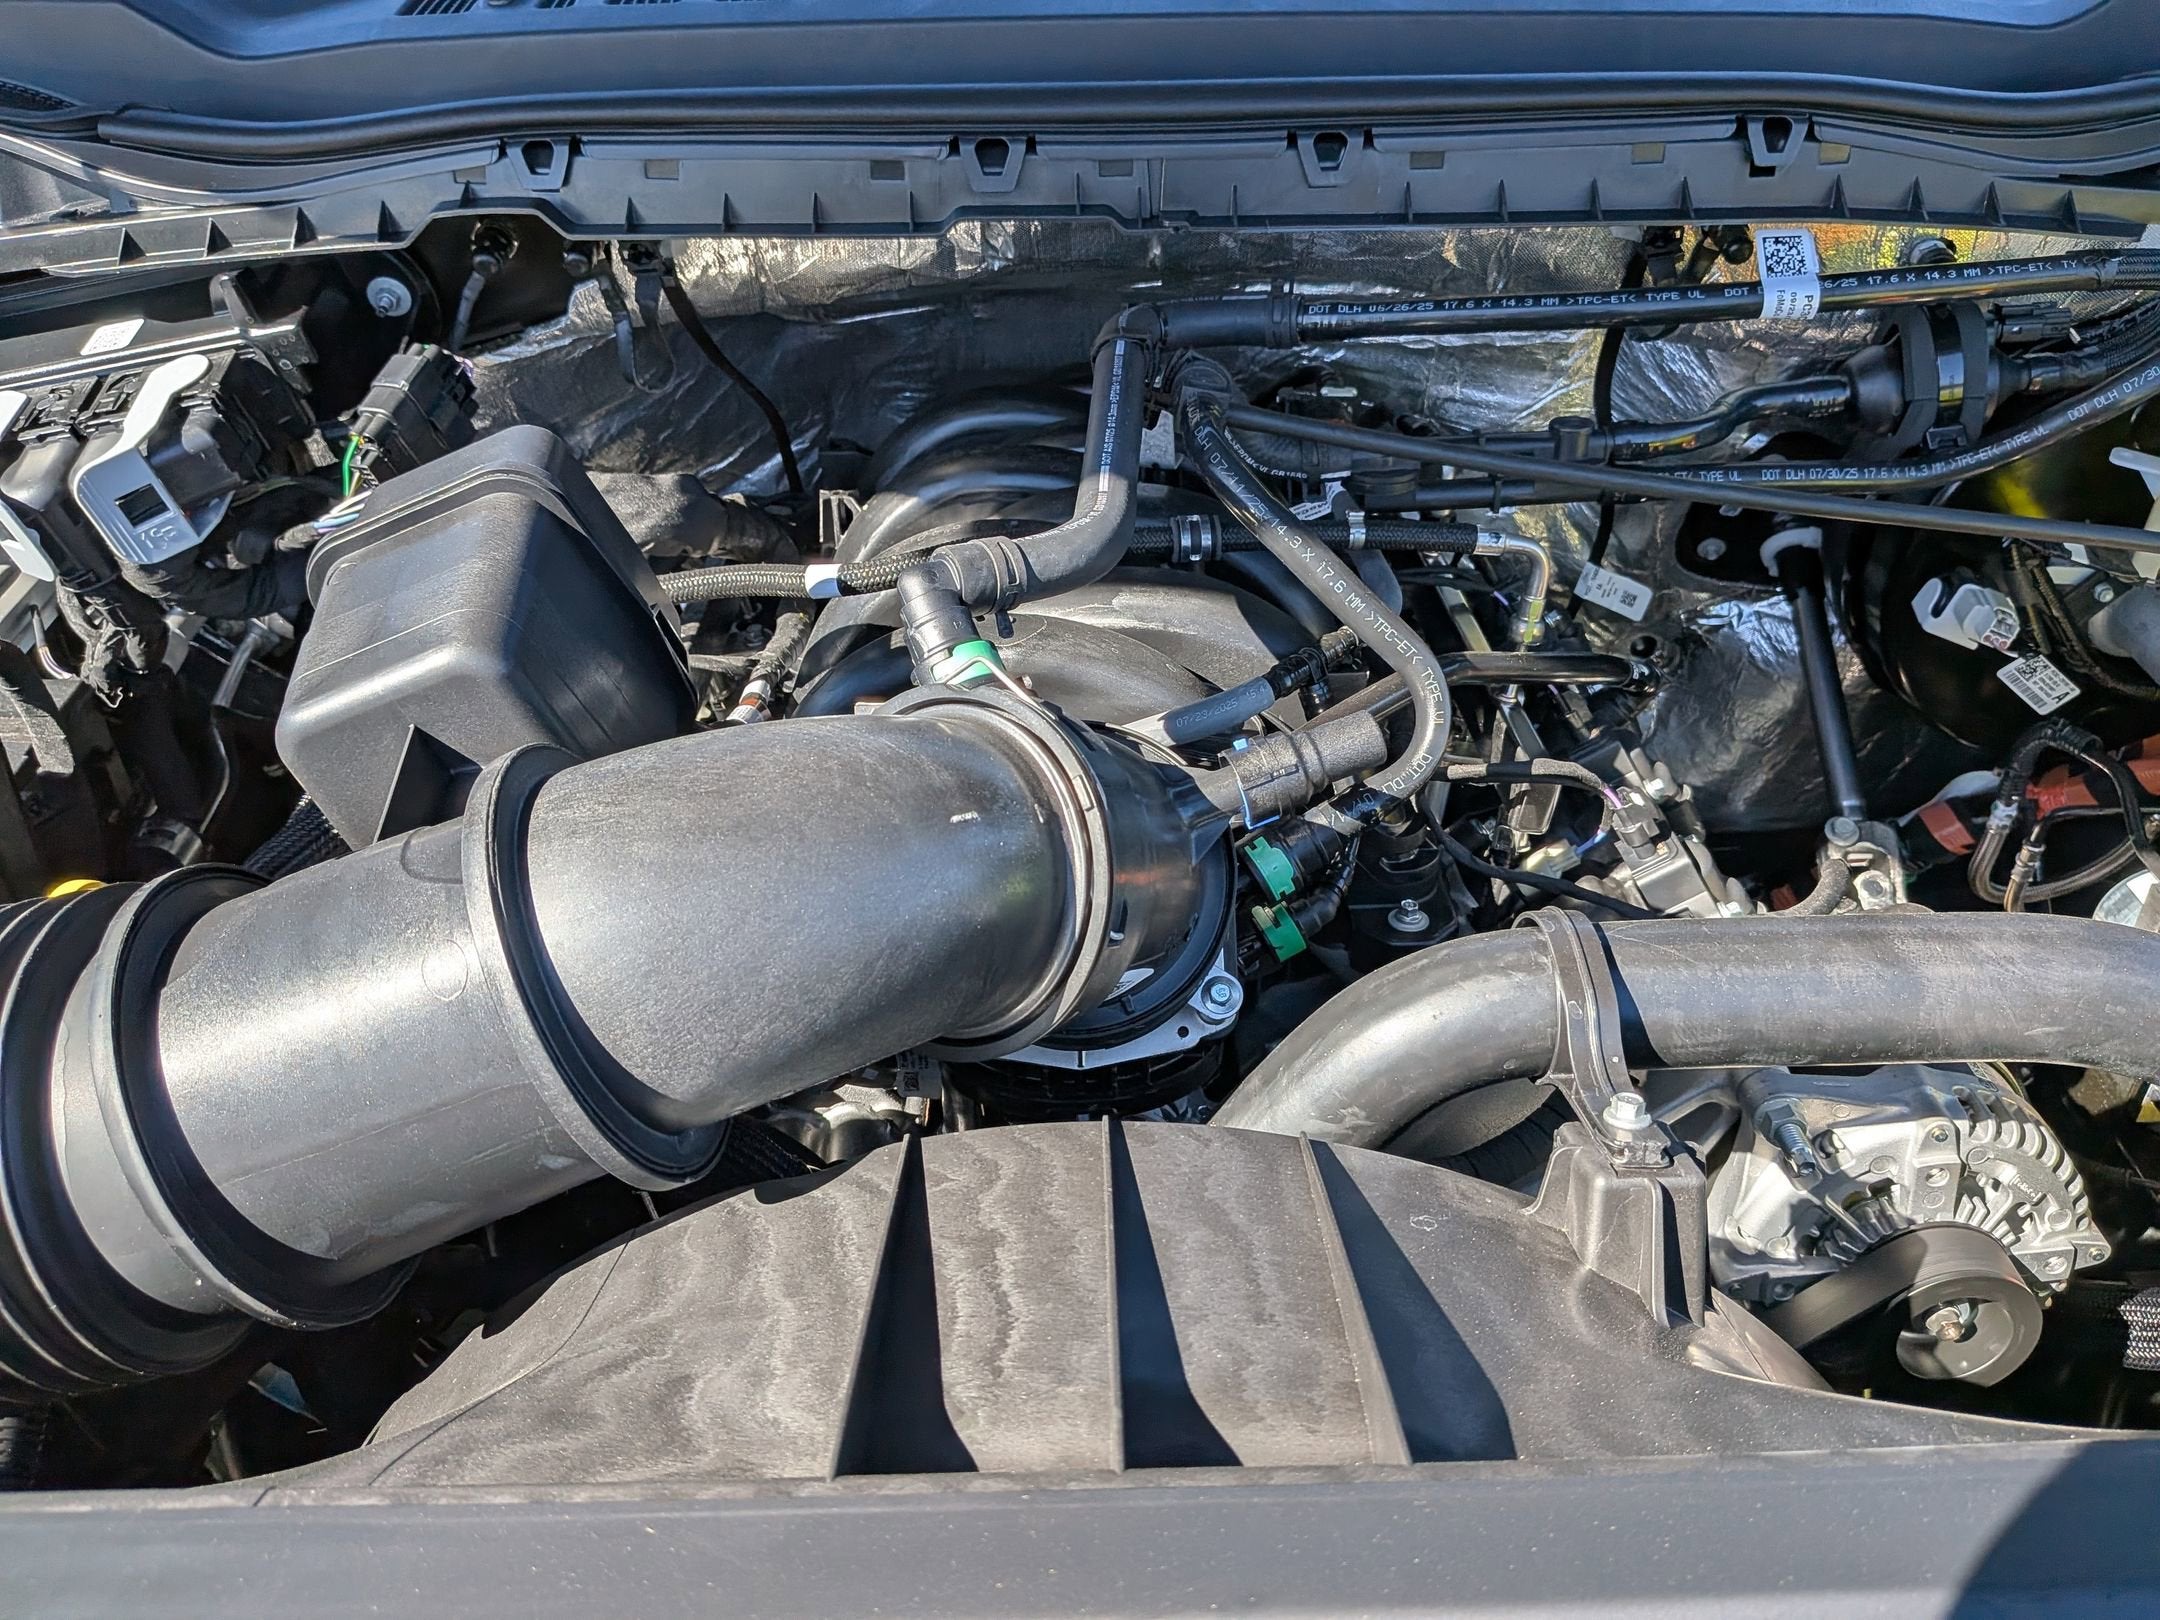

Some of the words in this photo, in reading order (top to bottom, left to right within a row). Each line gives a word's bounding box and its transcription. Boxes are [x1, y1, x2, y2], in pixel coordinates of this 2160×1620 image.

[1866, 274, 1900, 285] 17.6
[1924, 270, 1957, 281] 14.3
[1963, 268, 1981, 277] MM
[1309, 305, 1329, 314] DOT
[1338, 305, 1362, 314] DLH
[1442, 300, 1475, 310] 17.6
[1500, 298, 1533, 308] 14.3
[1541, 298, 1559, 306] MM
[1645, 291, 1680, 302] TYPE
[1687, 290, 1705, 299] VL
[1724, 287, 1749, 297] DOT
[2067, 403, 2090, 421] DOT
[2094, 389, 2120, 408] DLH
[1699, 471, 1724, 481] TYPE
[1761, 469, 1780, 480] DOT
[1786, 469, 1805, 480] DLH
[1809, 467, 1859, 479] 07/30/25
[1904, 465, 1929, 477] 14.3
[2003, 431, 2032, 450] TYPE
[1194, 425, 1212, 451] DLH
[1271, 519, 1302, 549] 14.3
[1301, 547, 1316, 562] X
[1316, 561, 1347, 593] 17.6
[1345, 592, 1367, 613] MM
[1421, 666, 1443, 703] TYPE
[1176, 697, 1238, 727] 07/23/2025
[1408, 753, 1433, 780] DOT
